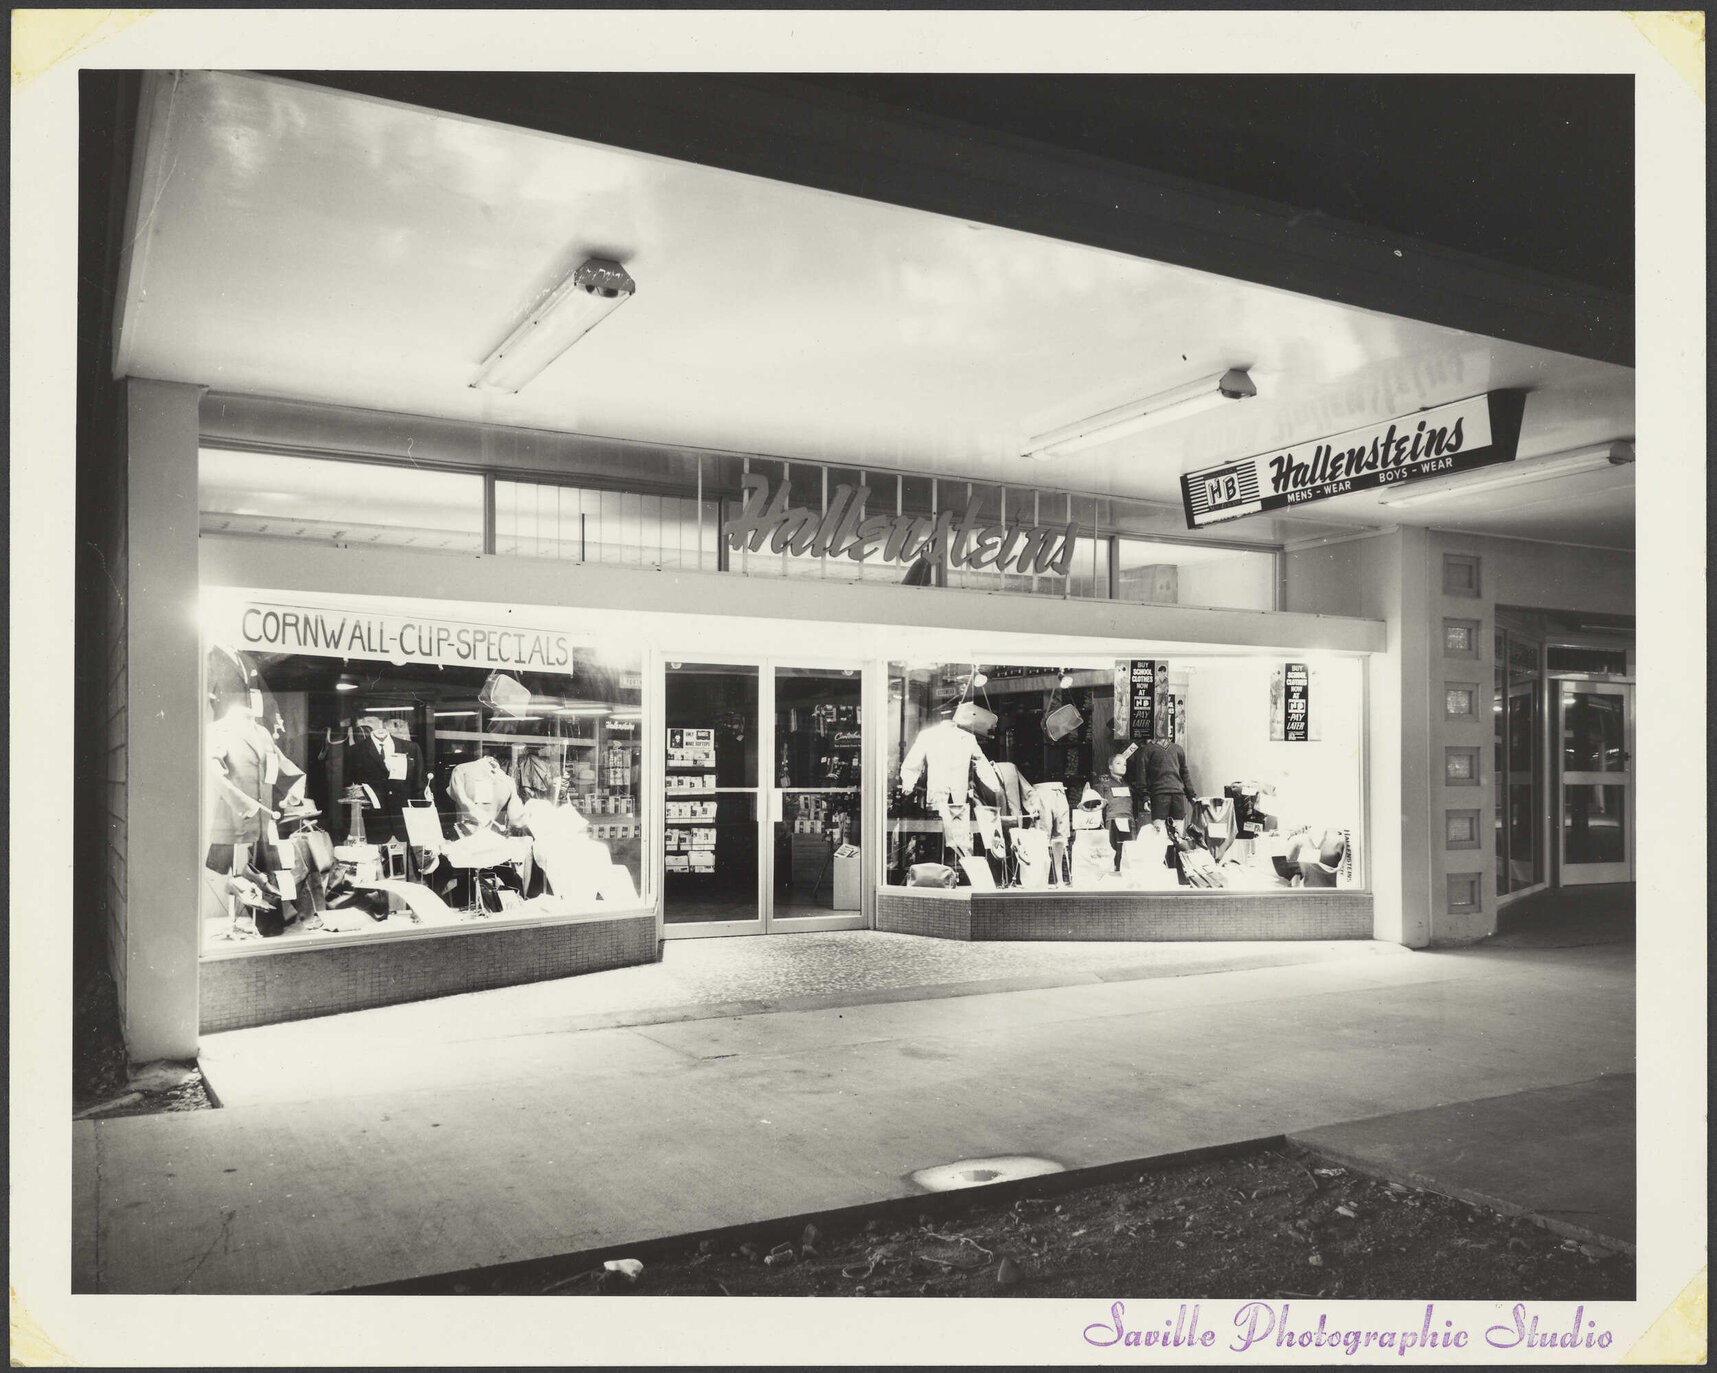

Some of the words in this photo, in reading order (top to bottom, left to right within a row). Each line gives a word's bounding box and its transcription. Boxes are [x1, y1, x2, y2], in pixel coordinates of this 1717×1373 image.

[1269, 416, 1465, 494] Hallensteins
[1379, 469, 1408, 483] BOYS
[1421, 457, 1454, 474] WEAR
[1207, 475, 1237, 504] HB
[1287, 489, 1313, 504] MENS
[1323, 481, 1352, 495] WEAR
[722, 472, 1081, 576] Hallensteins
[241, 608, 569, 667] CORNWALL-CUP-SPECIALS
[1131, 675, 1154, 683] CLOTHES
[1132, 668, 1153, 676] SCHOOL
[1132, 719, 1151, 727] LATER
[1286, 722, 1305, 730] LATER
